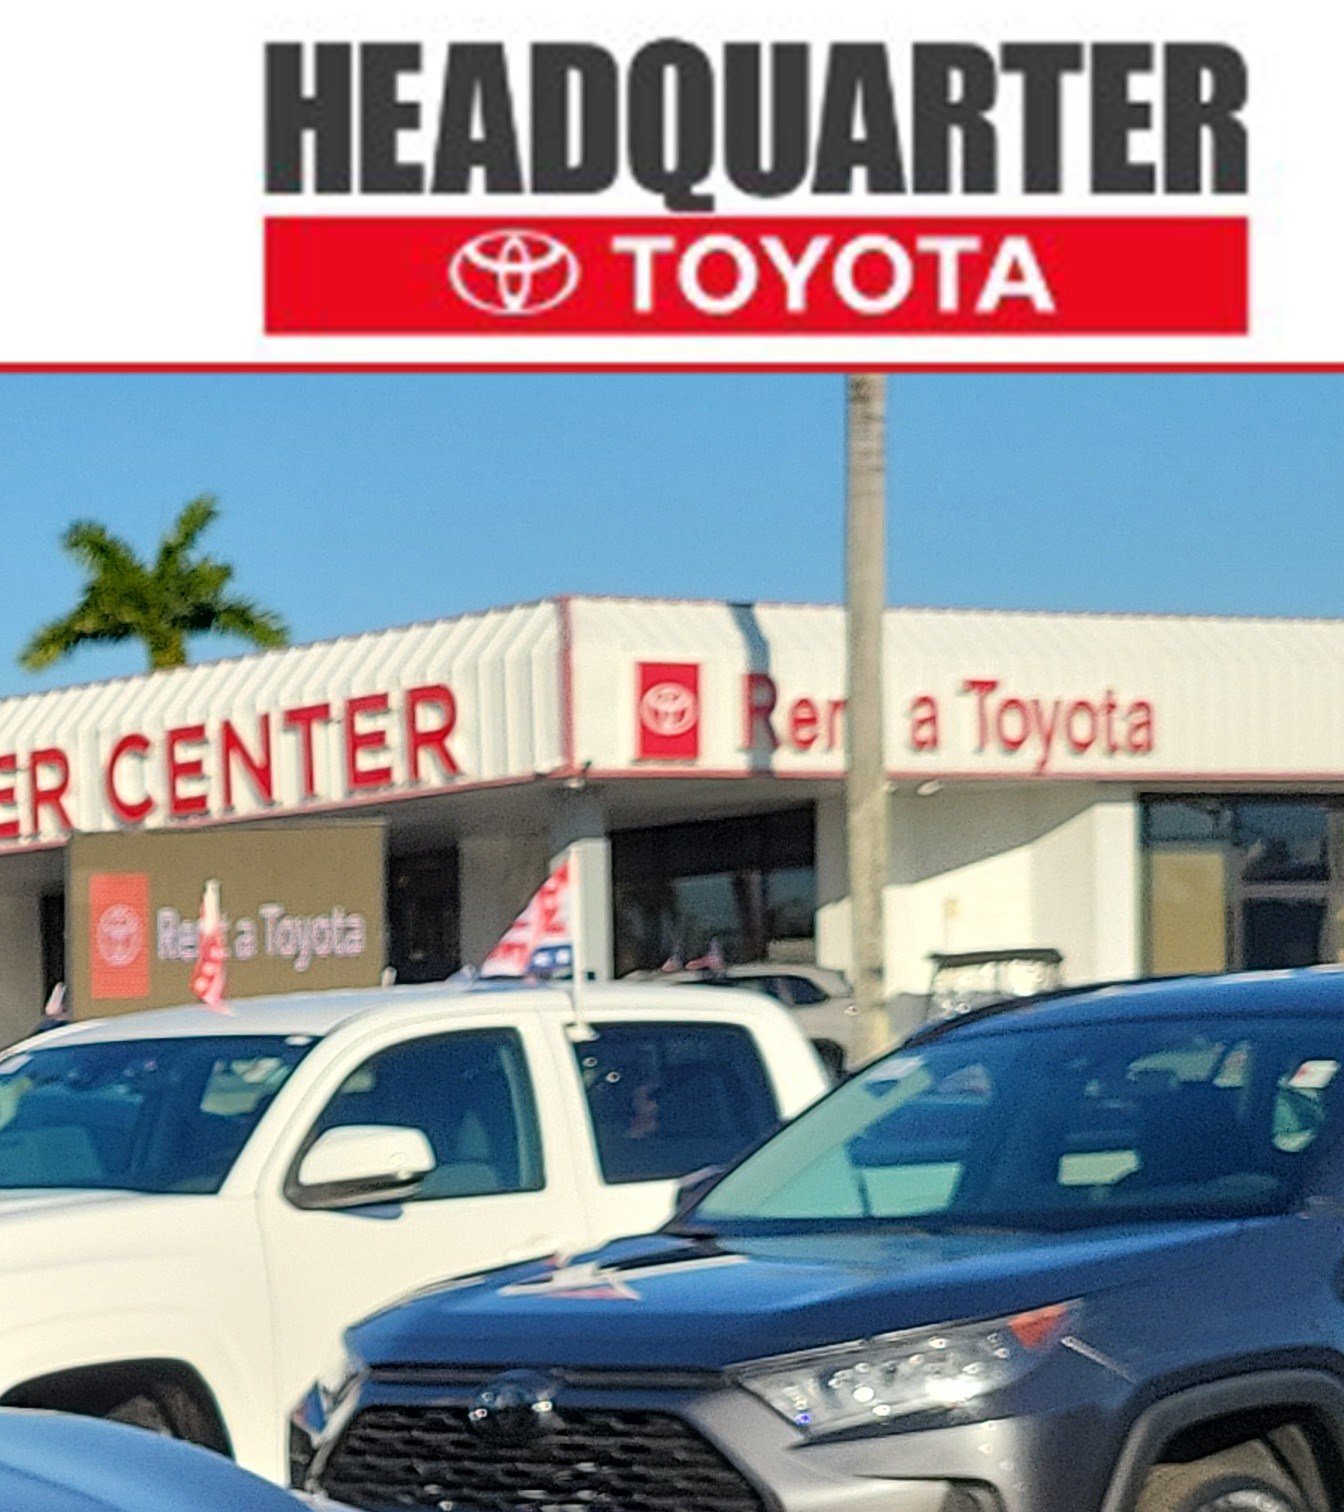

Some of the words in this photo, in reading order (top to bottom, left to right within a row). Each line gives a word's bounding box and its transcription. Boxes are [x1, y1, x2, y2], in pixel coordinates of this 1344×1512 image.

[104, 683, 460, 823] CENTER
[742, 672, 848, 752] Ren
[910, 696, 940, 751] a
[962, 679, 1155, 776] Toyota
[234, 917, 258, 961] a
[259, 902, 366, 973] Toyota
